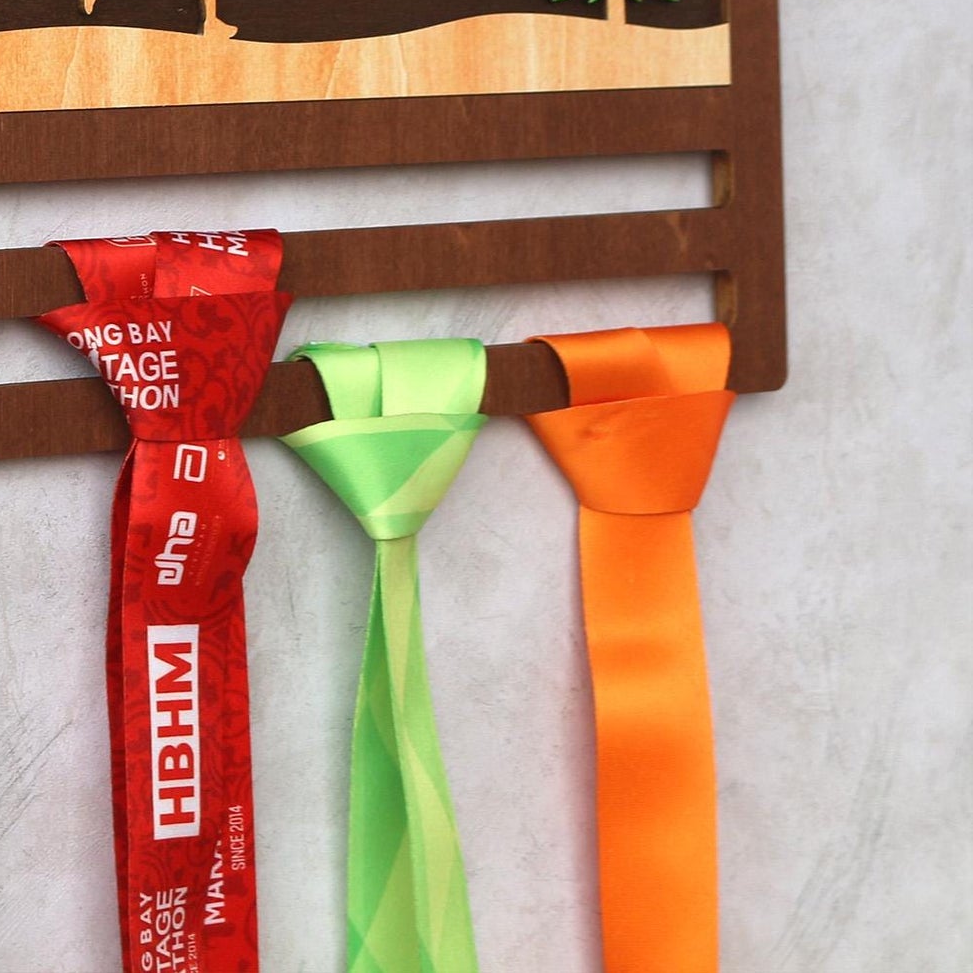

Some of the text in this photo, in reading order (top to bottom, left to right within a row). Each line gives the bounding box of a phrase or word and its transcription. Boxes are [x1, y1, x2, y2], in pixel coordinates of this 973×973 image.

[67, 321, 172, 350] ONG BAY
[154, 642, 195, 826] HBHM
[229, 804, 247, 871] SINCE 2014
[139, 892, 153, 944] BAY
[172, 886, 188, 973] THON
